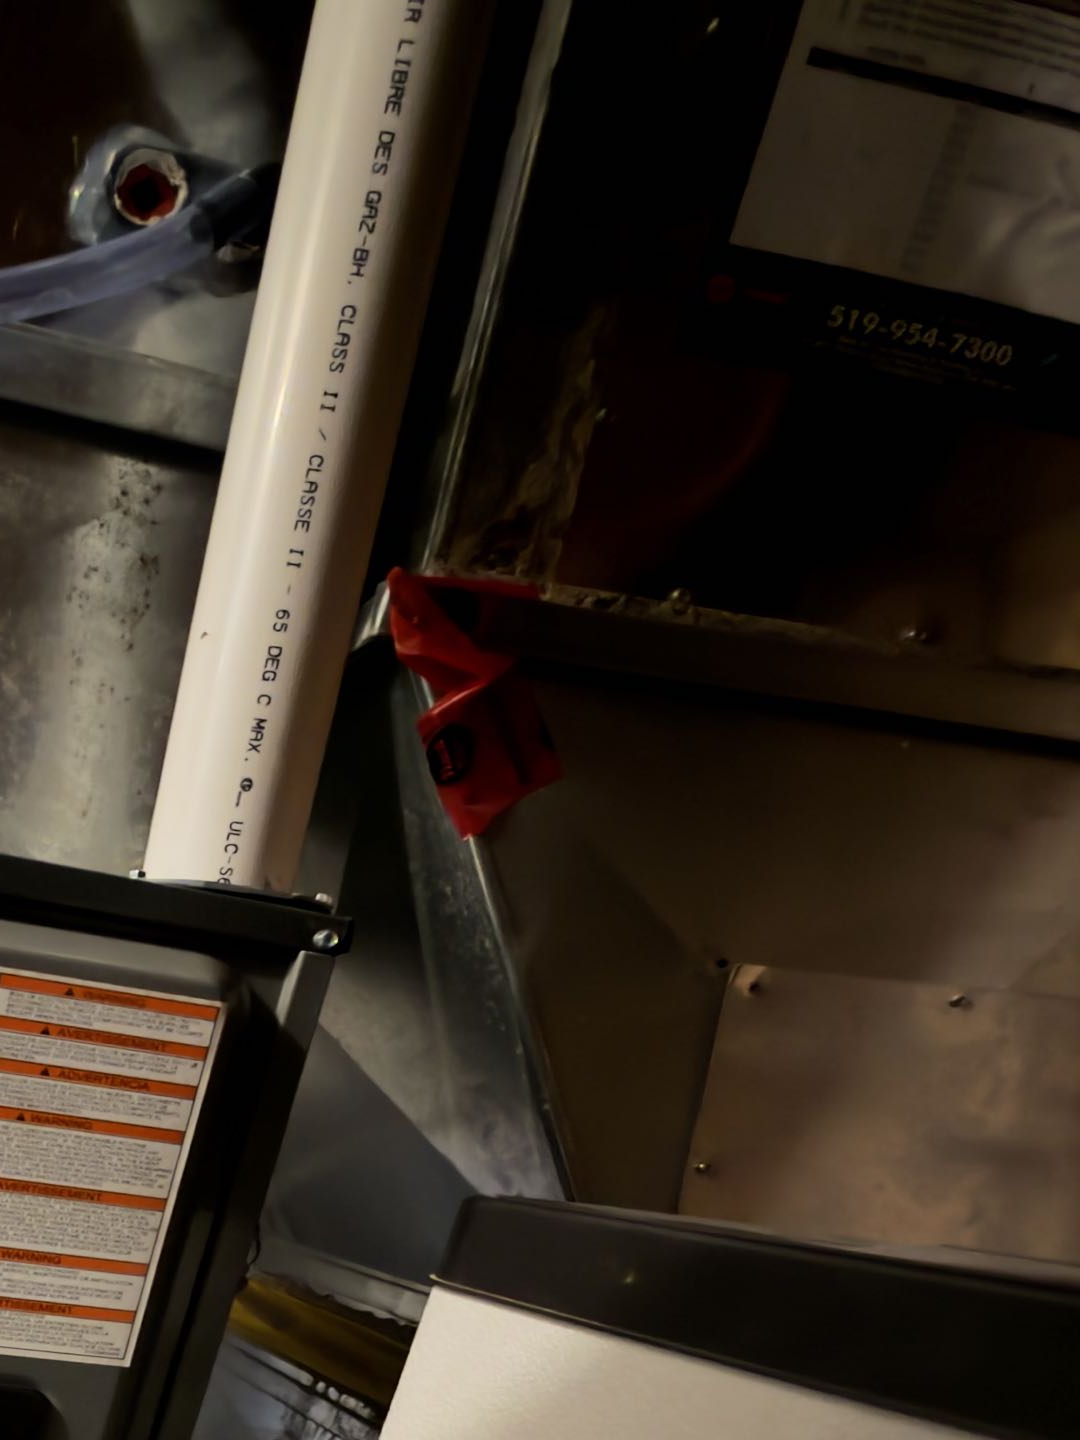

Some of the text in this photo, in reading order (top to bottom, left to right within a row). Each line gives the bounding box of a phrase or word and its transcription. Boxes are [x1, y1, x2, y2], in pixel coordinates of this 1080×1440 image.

[384, 39, 416, 117] LIBRE
[372, 130, 396, 176] DES
[329, 304, 357, 374] CLASS
[827, 304, 1013, 367] 519-954-7300
[320, 391, 338, 412] II
[294, 455, 324, 533] CLASSE
[286, 548, 304, 569] II
[273, 608, 291, 633] 65
[262, 645, 283, 682] DEG
[257, 694, 272, 706] C
[244, 717, 268, 762] MAX.
[30, 1113, 94, 1131] WARNING
[0, 1250, 62, 1265] WARNING
